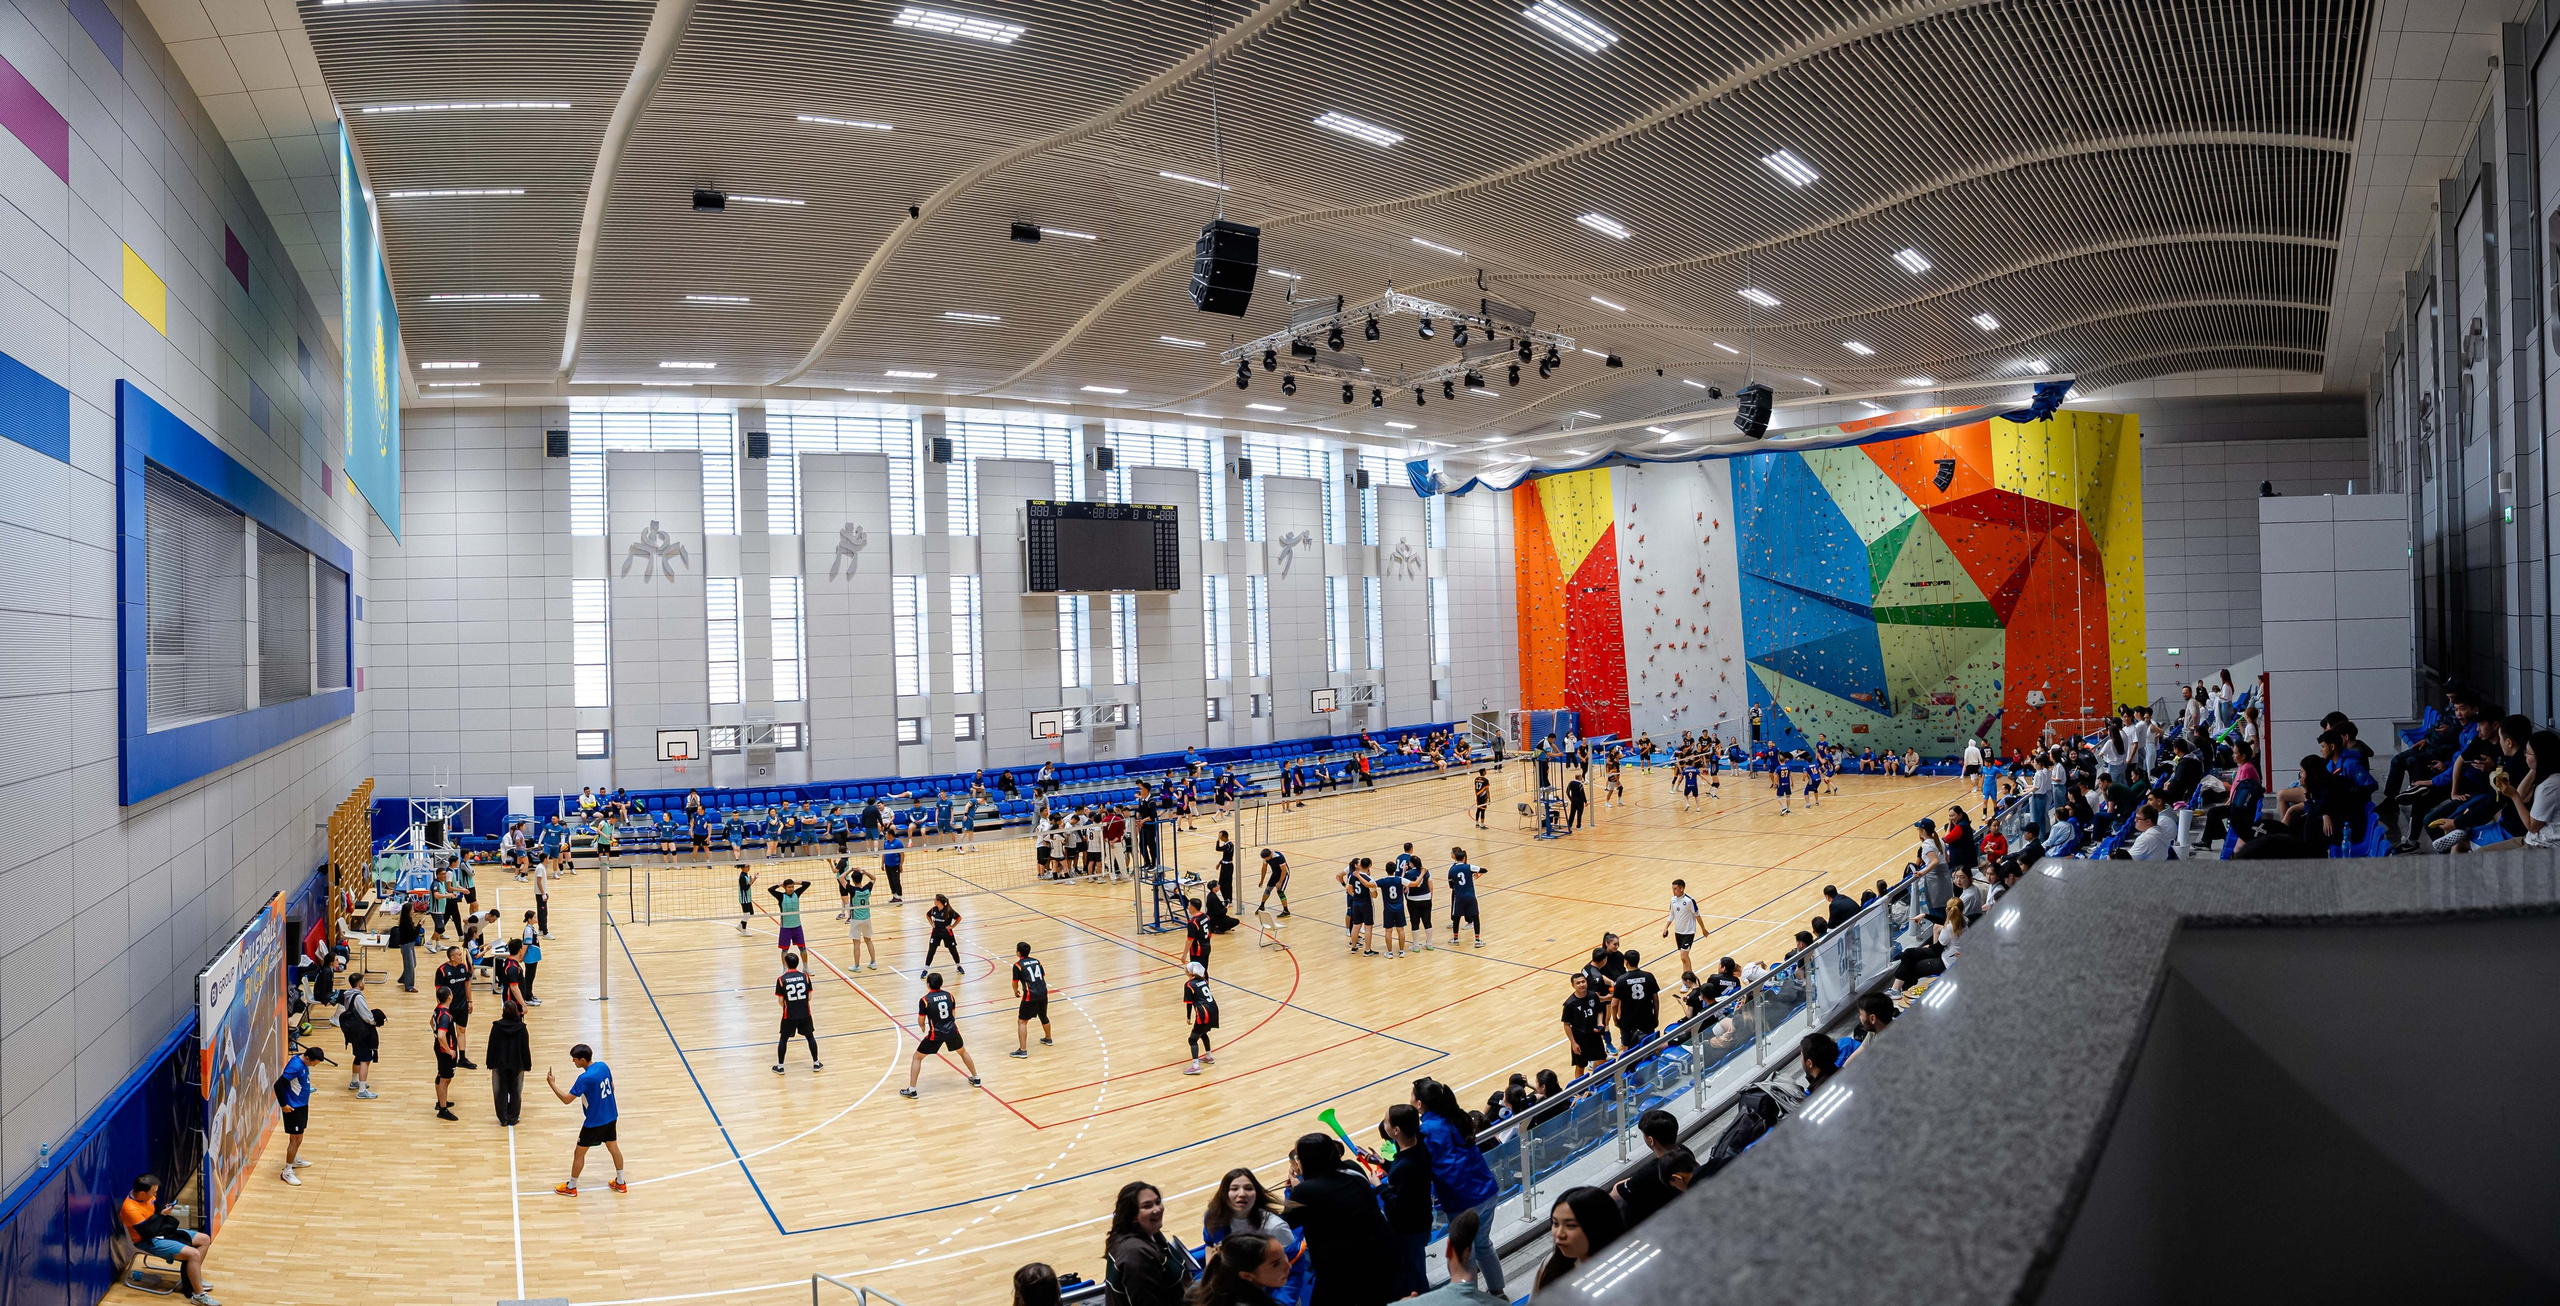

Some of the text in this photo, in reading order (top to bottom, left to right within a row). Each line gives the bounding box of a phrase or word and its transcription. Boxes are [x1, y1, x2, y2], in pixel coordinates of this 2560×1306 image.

[1457, 872, 1466, 886] 3
[1354, 881, 1362, 895] 5
[1389, 886, 1398, 899] 8
[1203, 924, 1210, 939] 5
[238, 917, 277, 980] VOLLEYBALL
[218, 967, 235, 995] GROUP
[244, 953, 270, 1008] BI CUP
[1027, 964, 1042, 982] 14
[786, 983, 806, 1001] 22
[1202, 987, 1213, 1002] 9
[1631, 983, 1645, 1000] 8
[938, 1002, 949, 1019] 8
[1583, 1008, 1594, 1018] 13
[600, 1077, 612, 1099] 23
